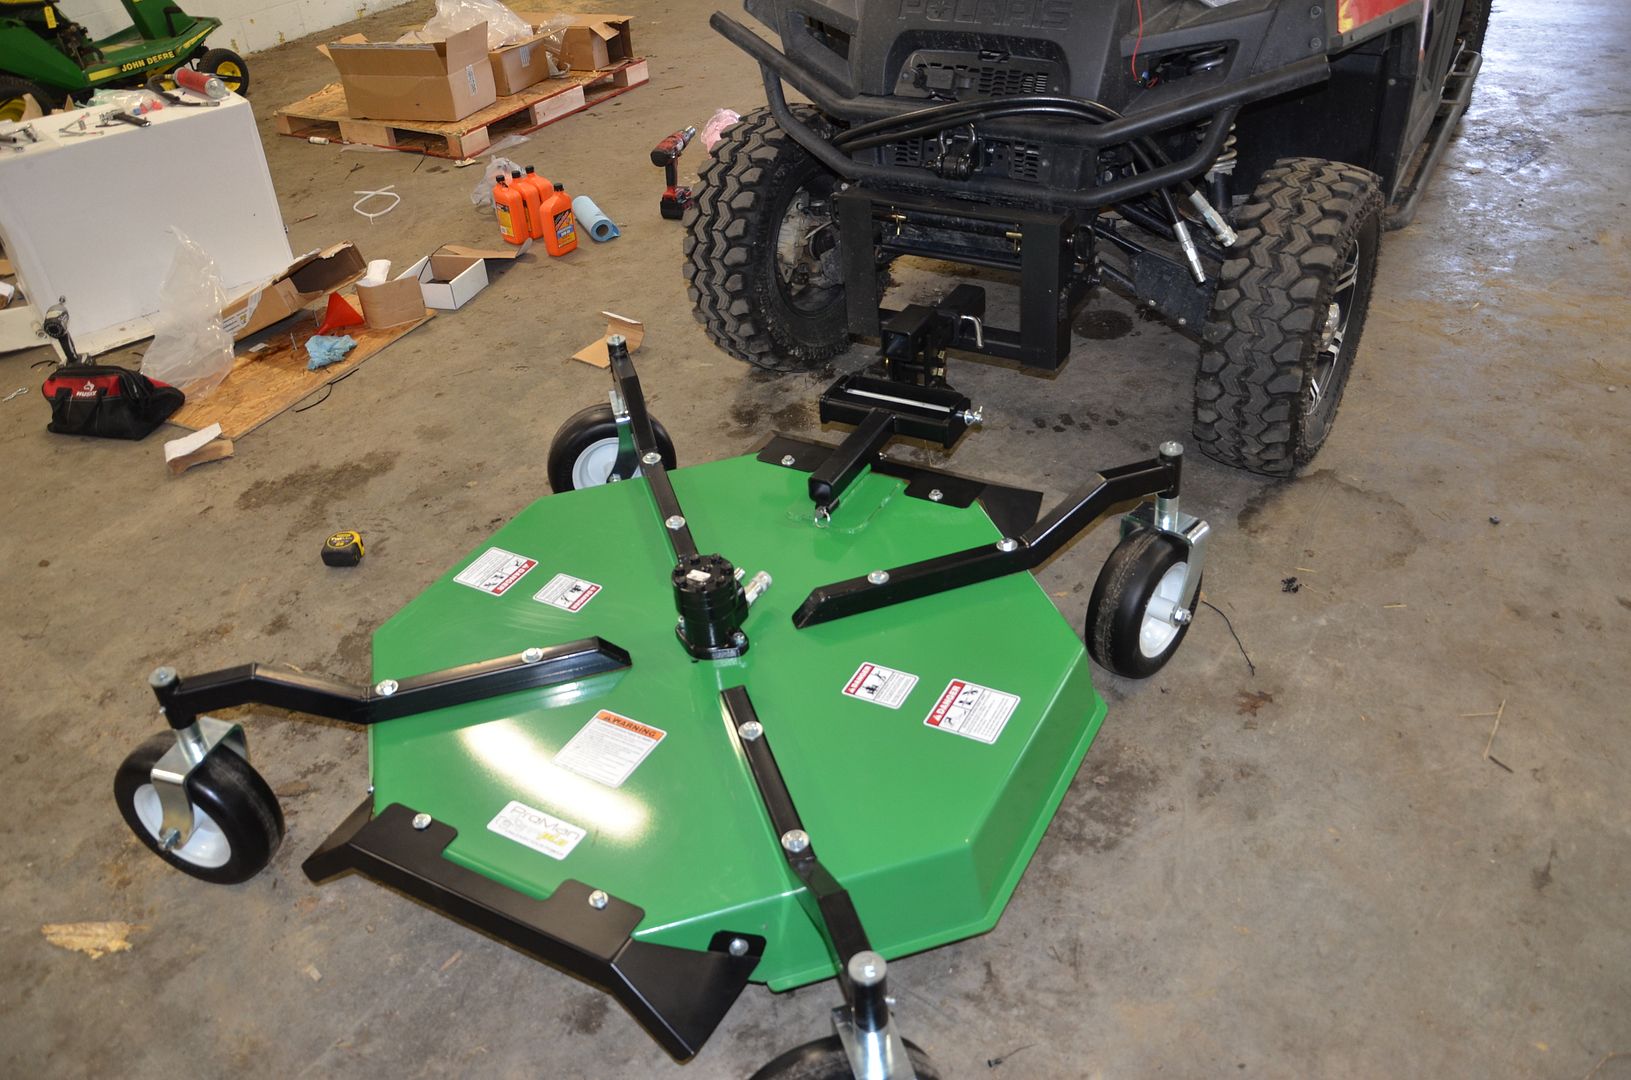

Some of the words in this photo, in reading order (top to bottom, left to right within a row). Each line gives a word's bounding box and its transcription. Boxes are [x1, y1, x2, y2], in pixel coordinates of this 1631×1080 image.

[121, 59, 146, 72] JOHN
[146, 50, 176, 65] DEERE
[496, 565, 526, 591] DANGER
[933, 683, 961, 715] DANGER
[612, 717, 657, 738] WARNING
